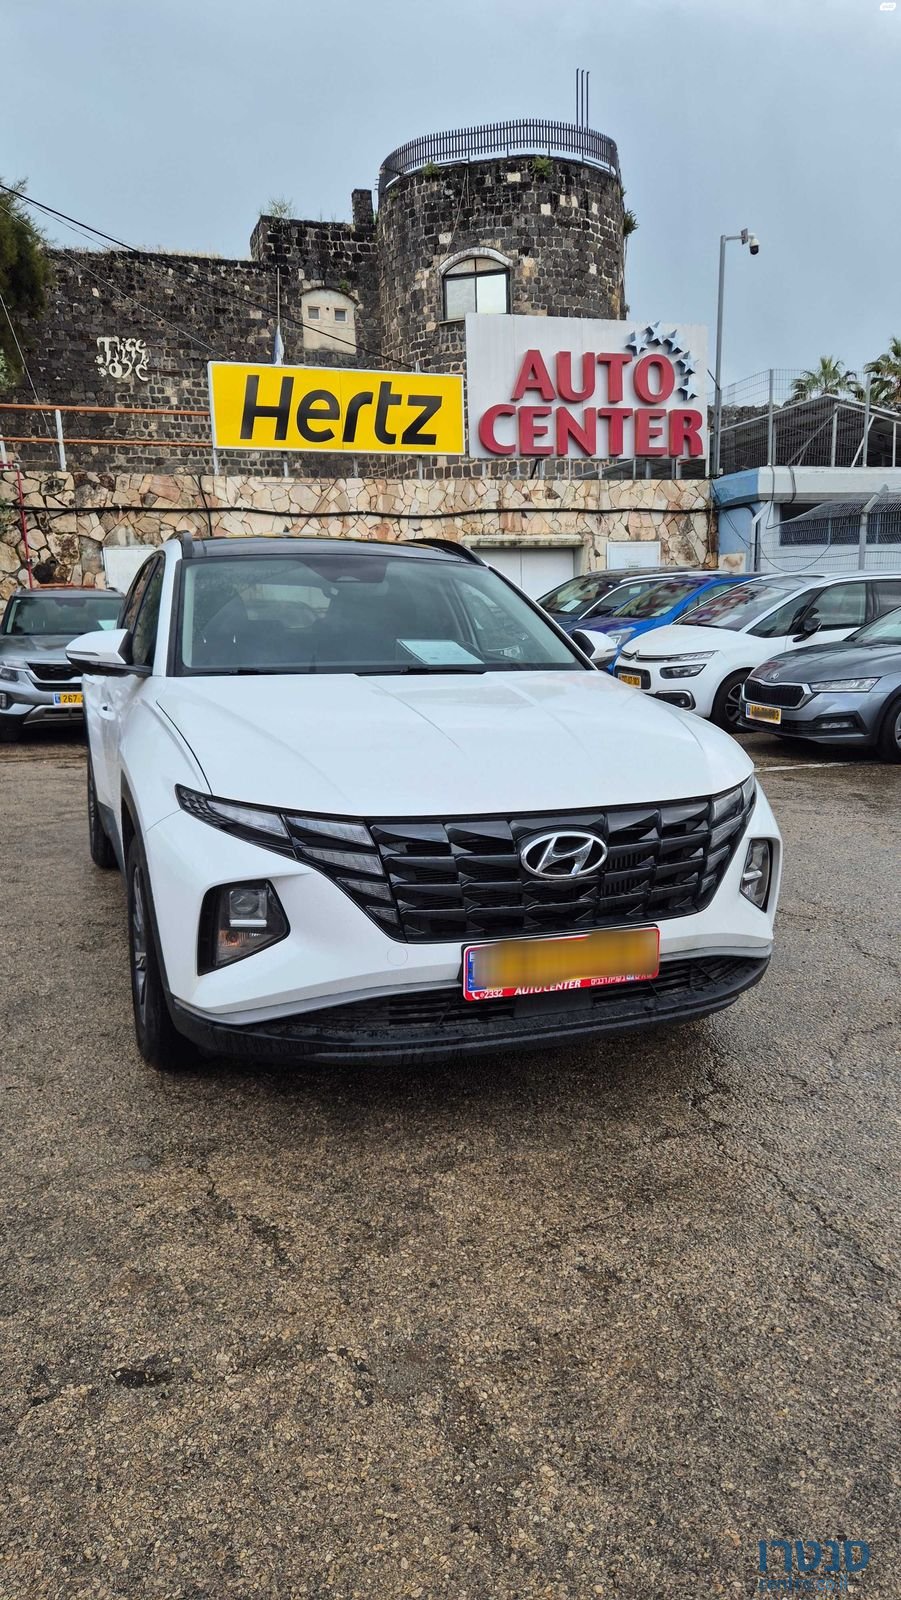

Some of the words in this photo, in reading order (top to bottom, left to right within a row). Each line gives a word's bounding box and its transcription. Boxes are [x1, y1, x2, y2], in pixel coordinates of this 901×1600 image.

[511, 349, 676, 404] AUTO
[240, 374, 442, 445] Hertz
[478, 403, 704, 458] CENTER
[514, 984, 543, 996] AUTO
[543, 979, 582, 992] CENTER
